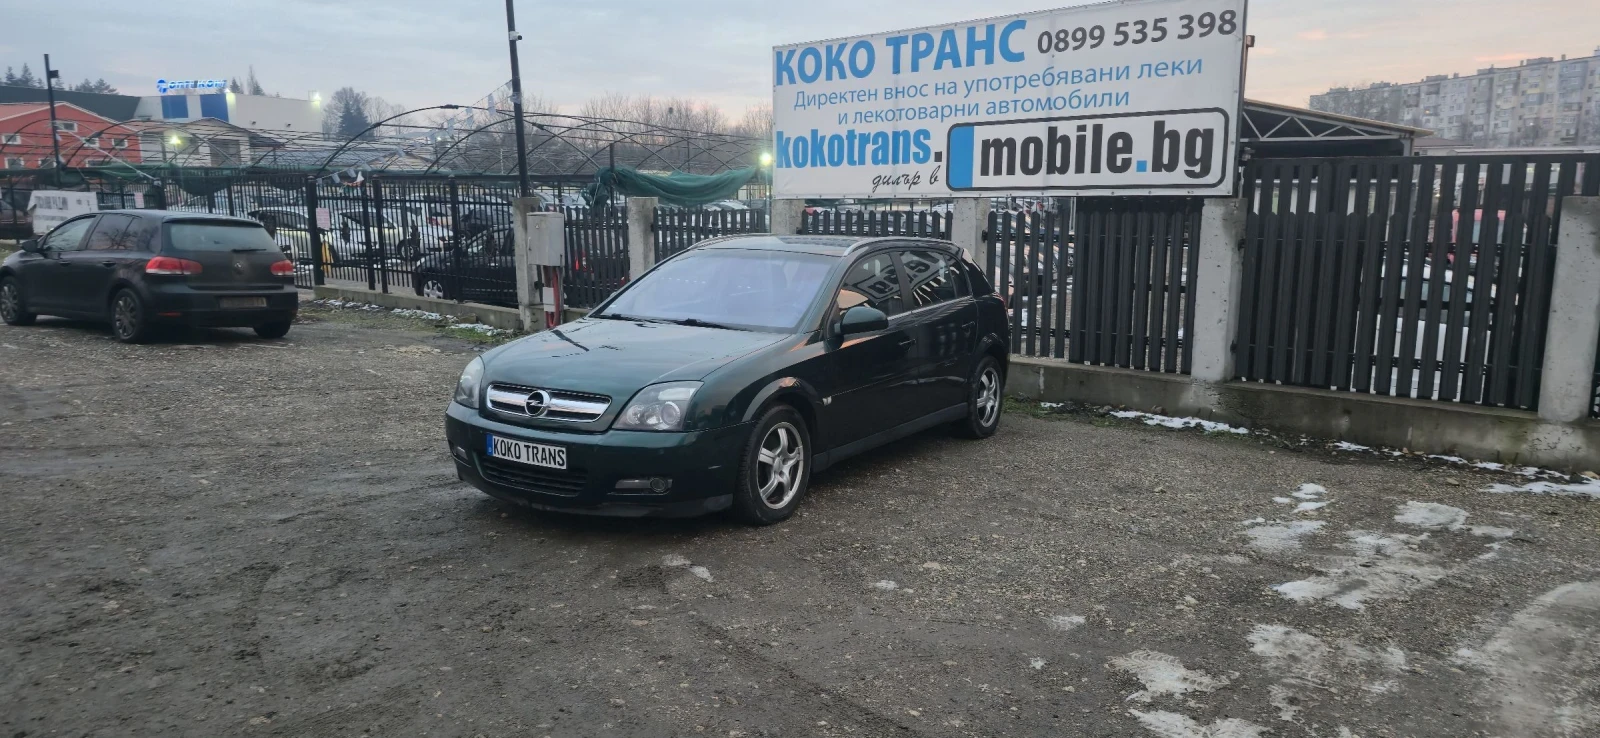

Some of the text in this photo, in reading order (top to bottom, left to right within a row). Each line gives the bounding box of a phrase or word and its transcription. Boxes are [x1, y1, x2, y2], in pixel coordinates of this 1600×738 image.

[775, 19, 1027, 87] КОКО ТРАНС
[1037, 9, 1237, 54] 0899 535 398
[794, 58, 1203, 111] Директен внос на употребявани леки
[838, 89, 1130, 126] и лекотоварни автомобили
[980, 120, 1215, 179] mobile.bg
[872, 171, 922, 194] дилър
[493, 437, 566, 467] KOKO TRANS
